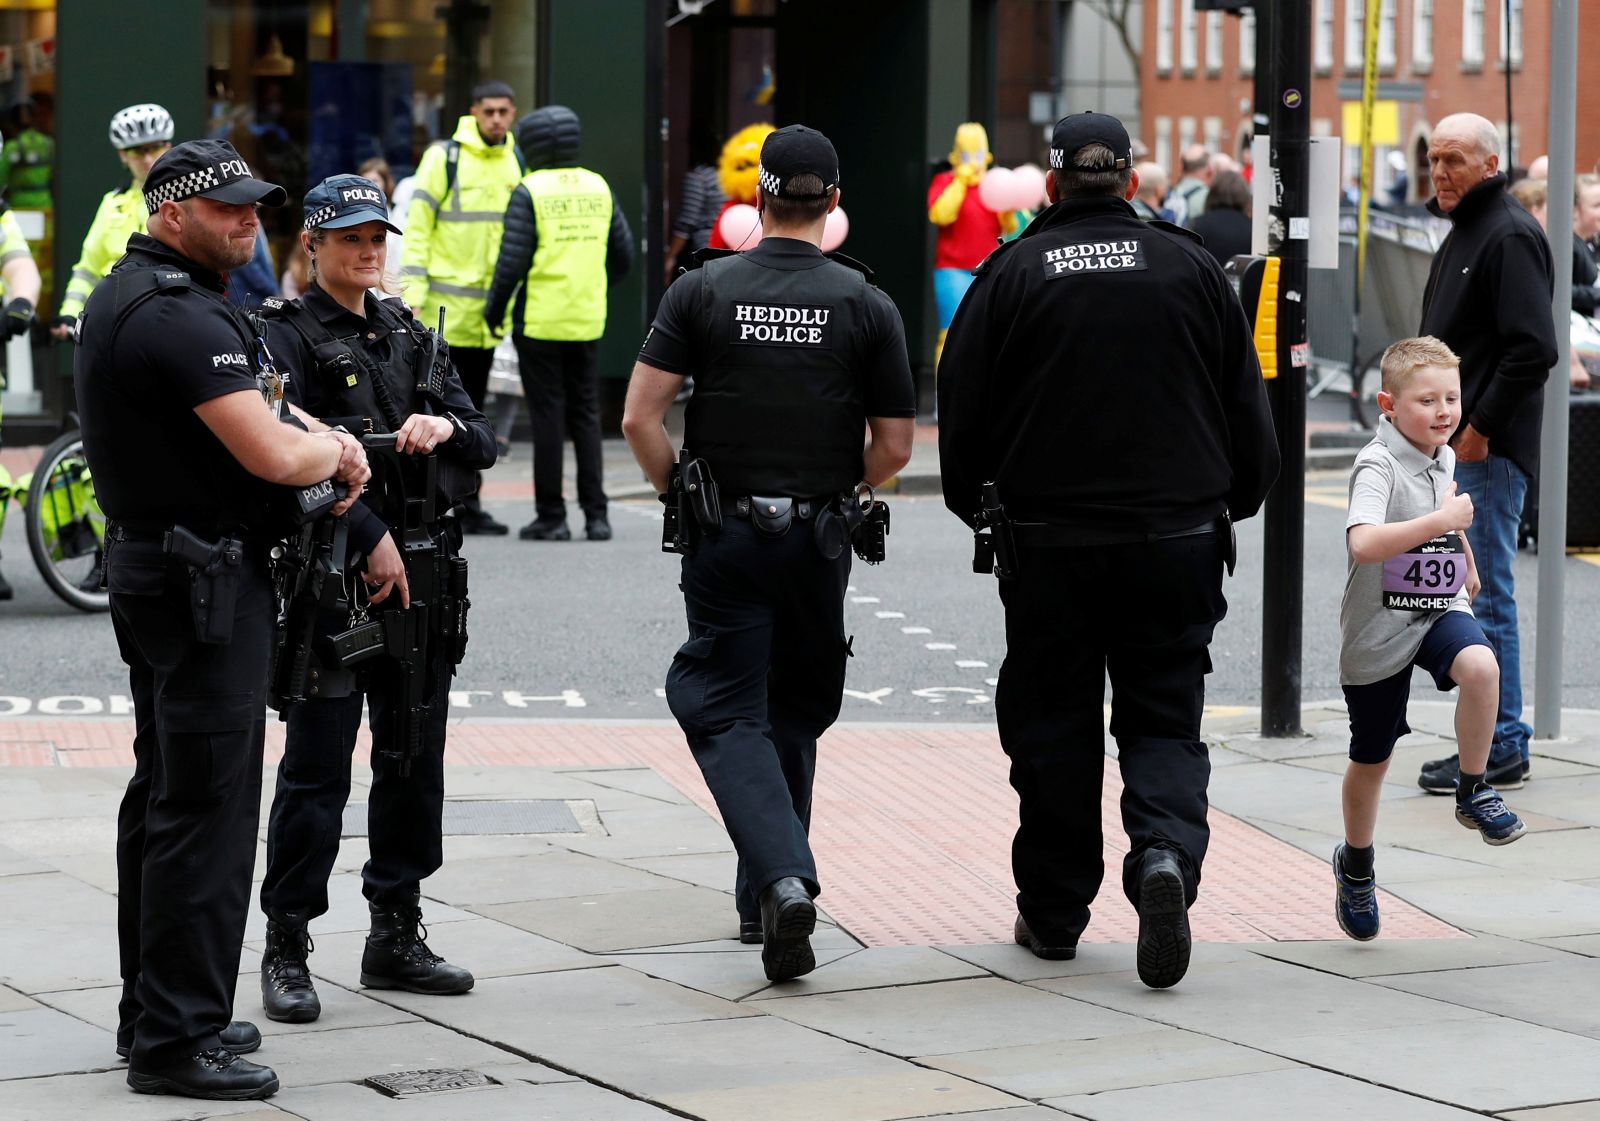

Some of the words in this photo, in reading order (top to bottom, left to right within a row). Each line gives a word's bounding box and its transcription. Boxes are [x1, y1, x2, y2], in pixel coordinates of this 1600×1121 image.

[342, 189, 381, 203] POLICE
[1045, 241, 1138, 263] HEDDLU
[1054, 255, 1136, 273] POLICE
[262, 298, 284, 309] 2628
[735, 305, 830, 325] HEDDLU
[740, 324, 822, 343] POLICE
[212, 353, 249, 367] POLICE
[1403, 560, 1456, 588] 439
